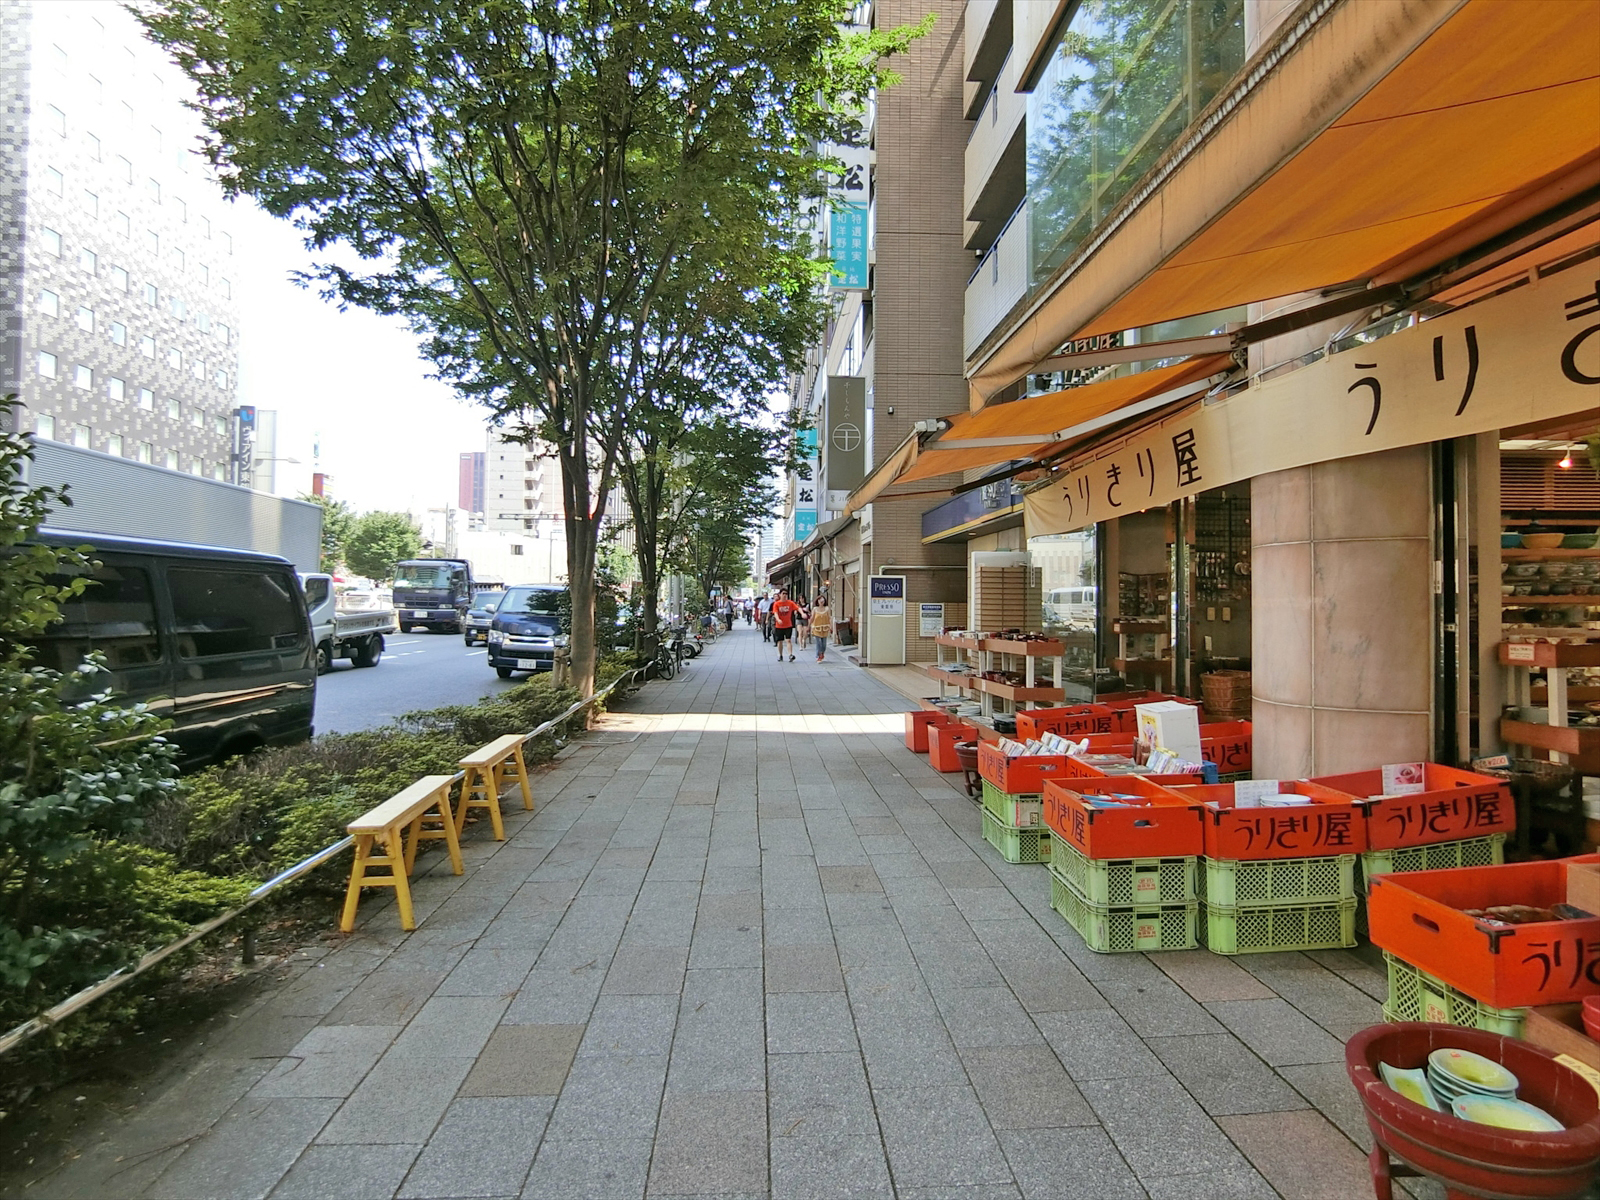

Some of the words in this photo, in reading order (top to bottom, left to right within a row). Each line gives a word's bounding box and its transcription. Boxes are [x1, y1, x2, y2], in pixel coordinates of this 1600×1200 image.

[851, 213, 862, 262] 特選果実
[1063, 428, 1202, 522] うりきり屋
[1048, 792, 1086, 847] うりきり屋
[1234, 812, 1354, 851] うりきり屋
[1386, 792, 1503, 839] うりきり屋
